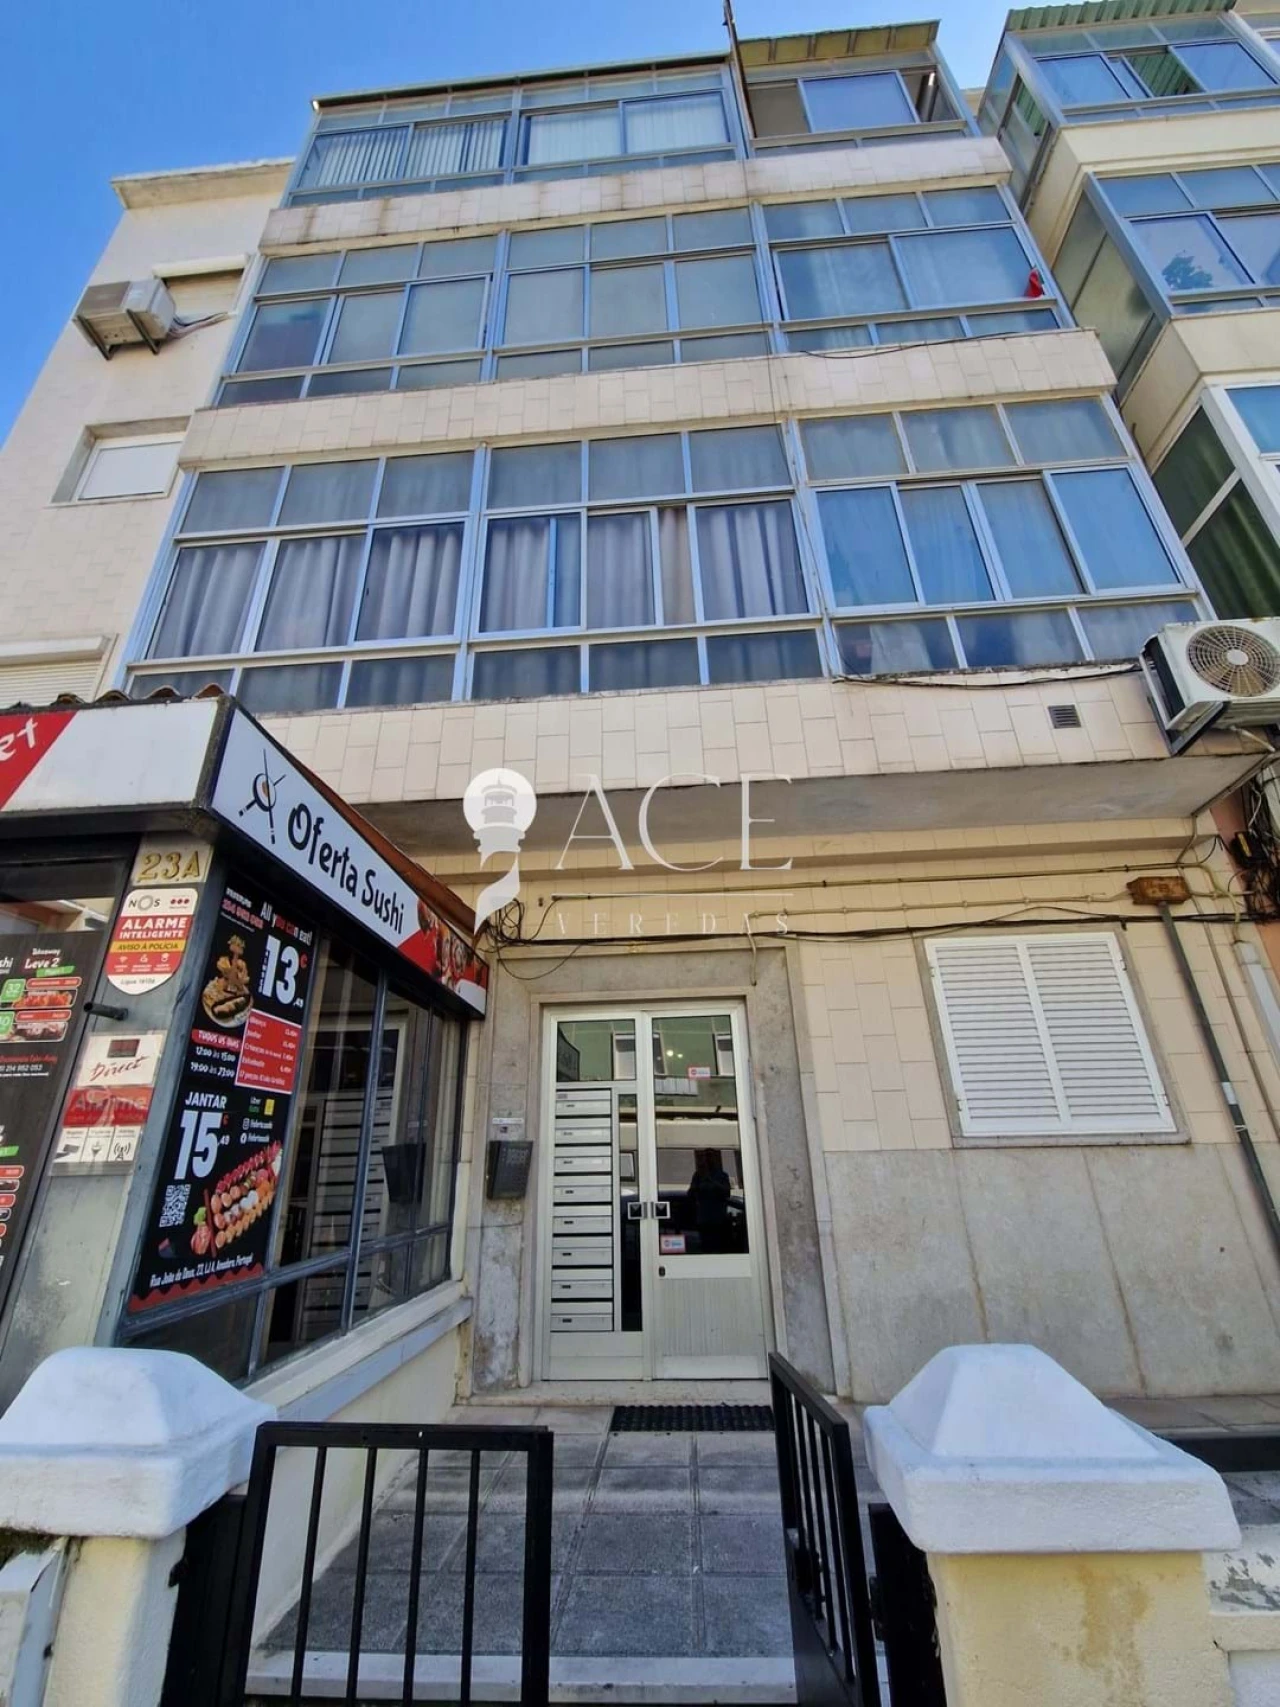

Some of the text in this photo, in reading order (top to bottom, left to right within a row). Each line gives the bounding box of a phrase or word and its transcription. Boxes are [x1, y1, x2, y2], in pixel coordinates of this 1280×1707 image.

[138, 850, 200, 880] 23A
[288, 803, 404, 934] Oferta Sushi
[128, 895, 160, 911] NOS
[260, 901, 273, 921] All
[122, 917, 188, 930] ALARME
[119, 930, 184, 939] INTELIGENTE
[117, 943, 141, 951] AVISO
[24, 957, 61, 970] Leve 2
[263, 935, 300, 1005] 13
[185, 1091, 227, 1109] JANTAR
[174, 1110, 223, 1180] 15
